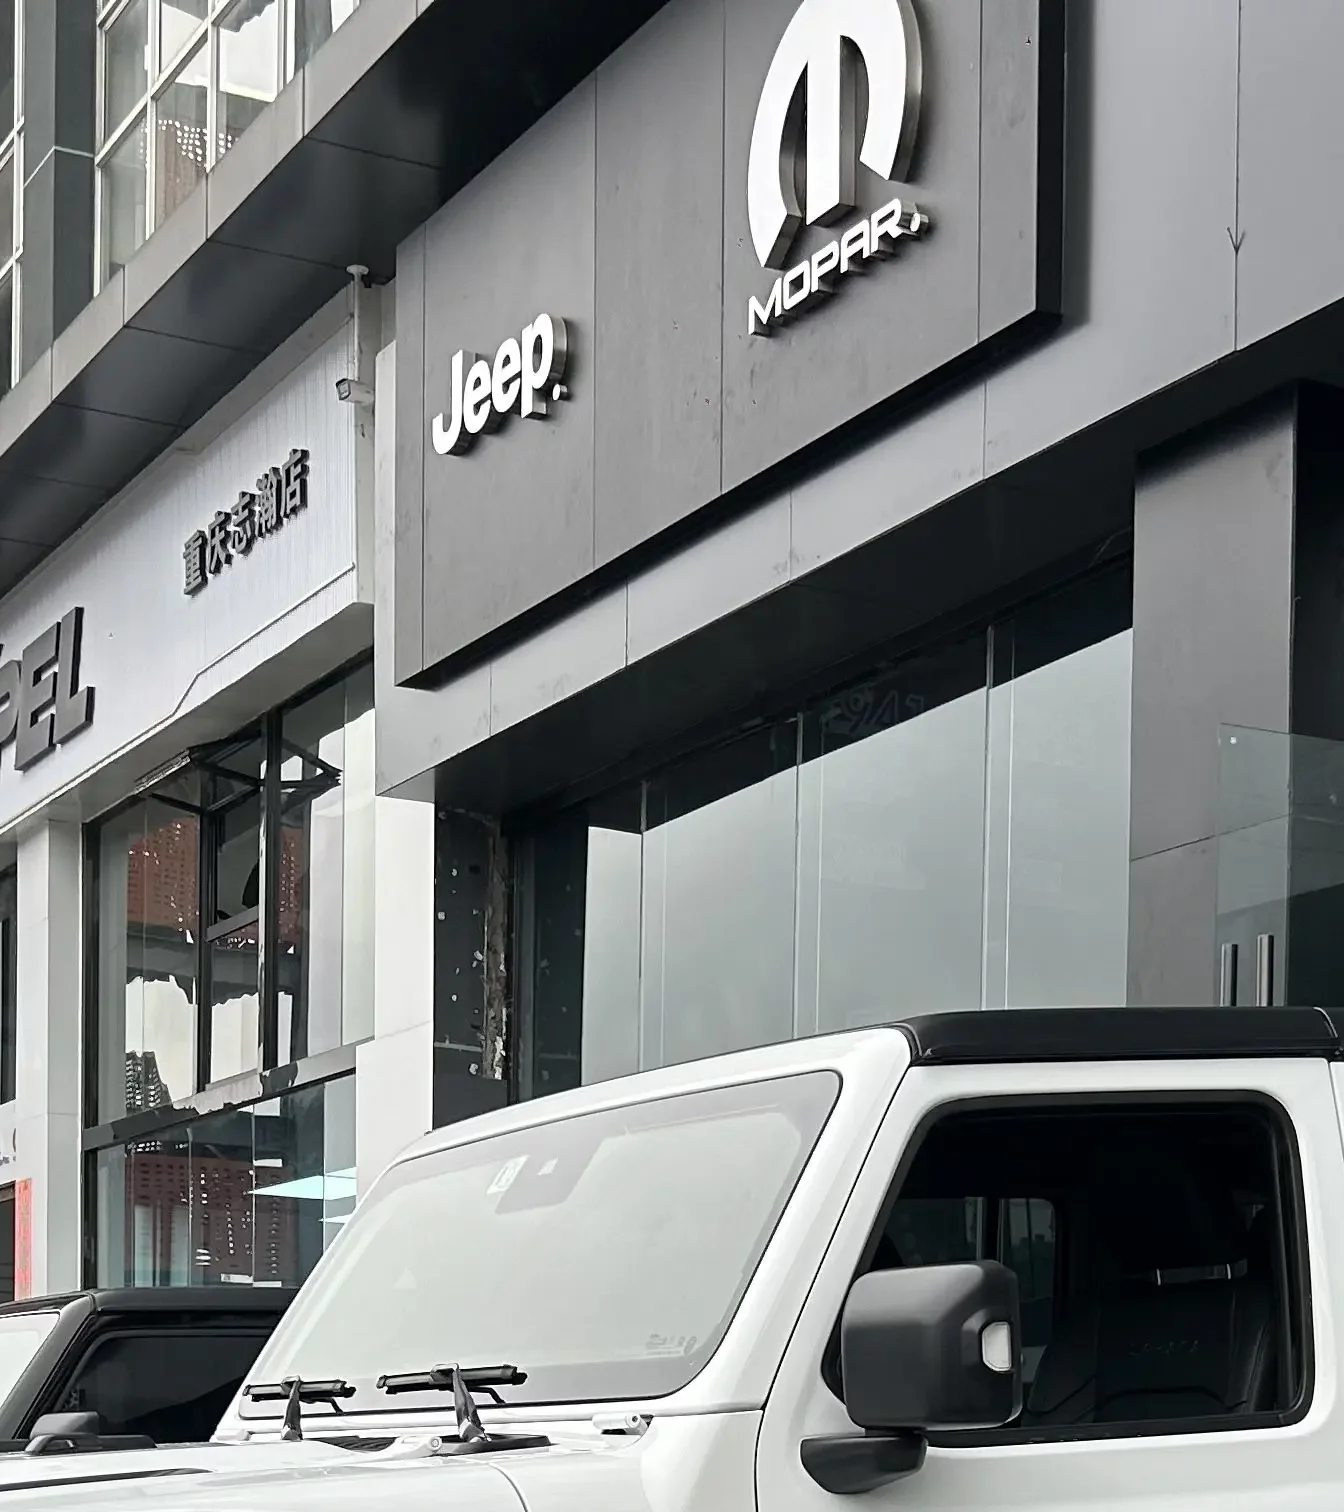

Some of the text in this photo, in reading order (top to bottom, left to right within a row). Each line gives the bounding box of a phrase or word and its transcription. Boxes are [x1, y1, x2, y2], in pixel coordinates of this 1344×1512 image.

[748, 197, 916, 335] MOPAR
[431, 312, 560, 455] Jeep
[183, 448, 310, 597] 重庆志瀚店
